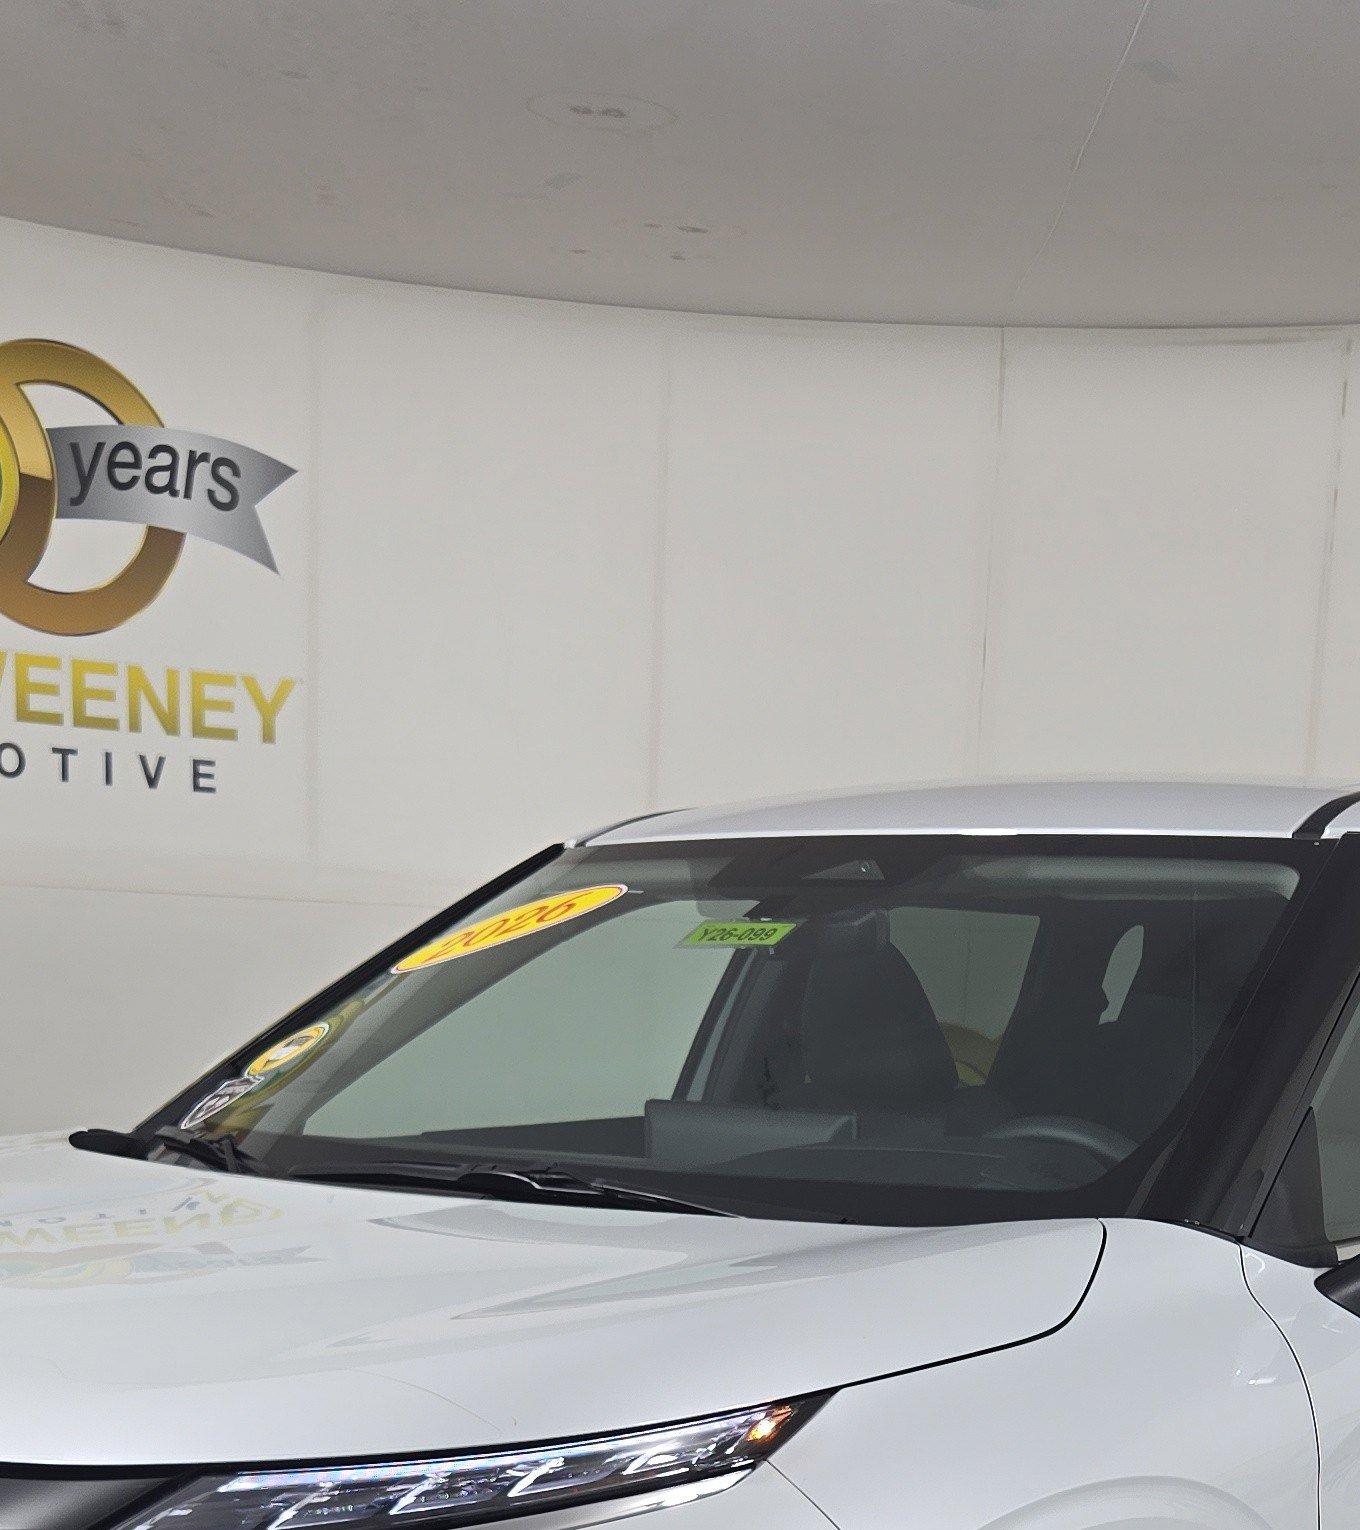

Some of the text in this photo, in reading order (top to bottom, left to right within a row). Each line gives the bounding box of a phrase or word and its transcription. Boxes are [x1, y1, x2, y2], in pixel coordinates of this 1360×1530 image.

[68, 438, 242, 512] years
[421, 891, 594, 964] 2026
[698, 928, 778, 941] Y26-099
